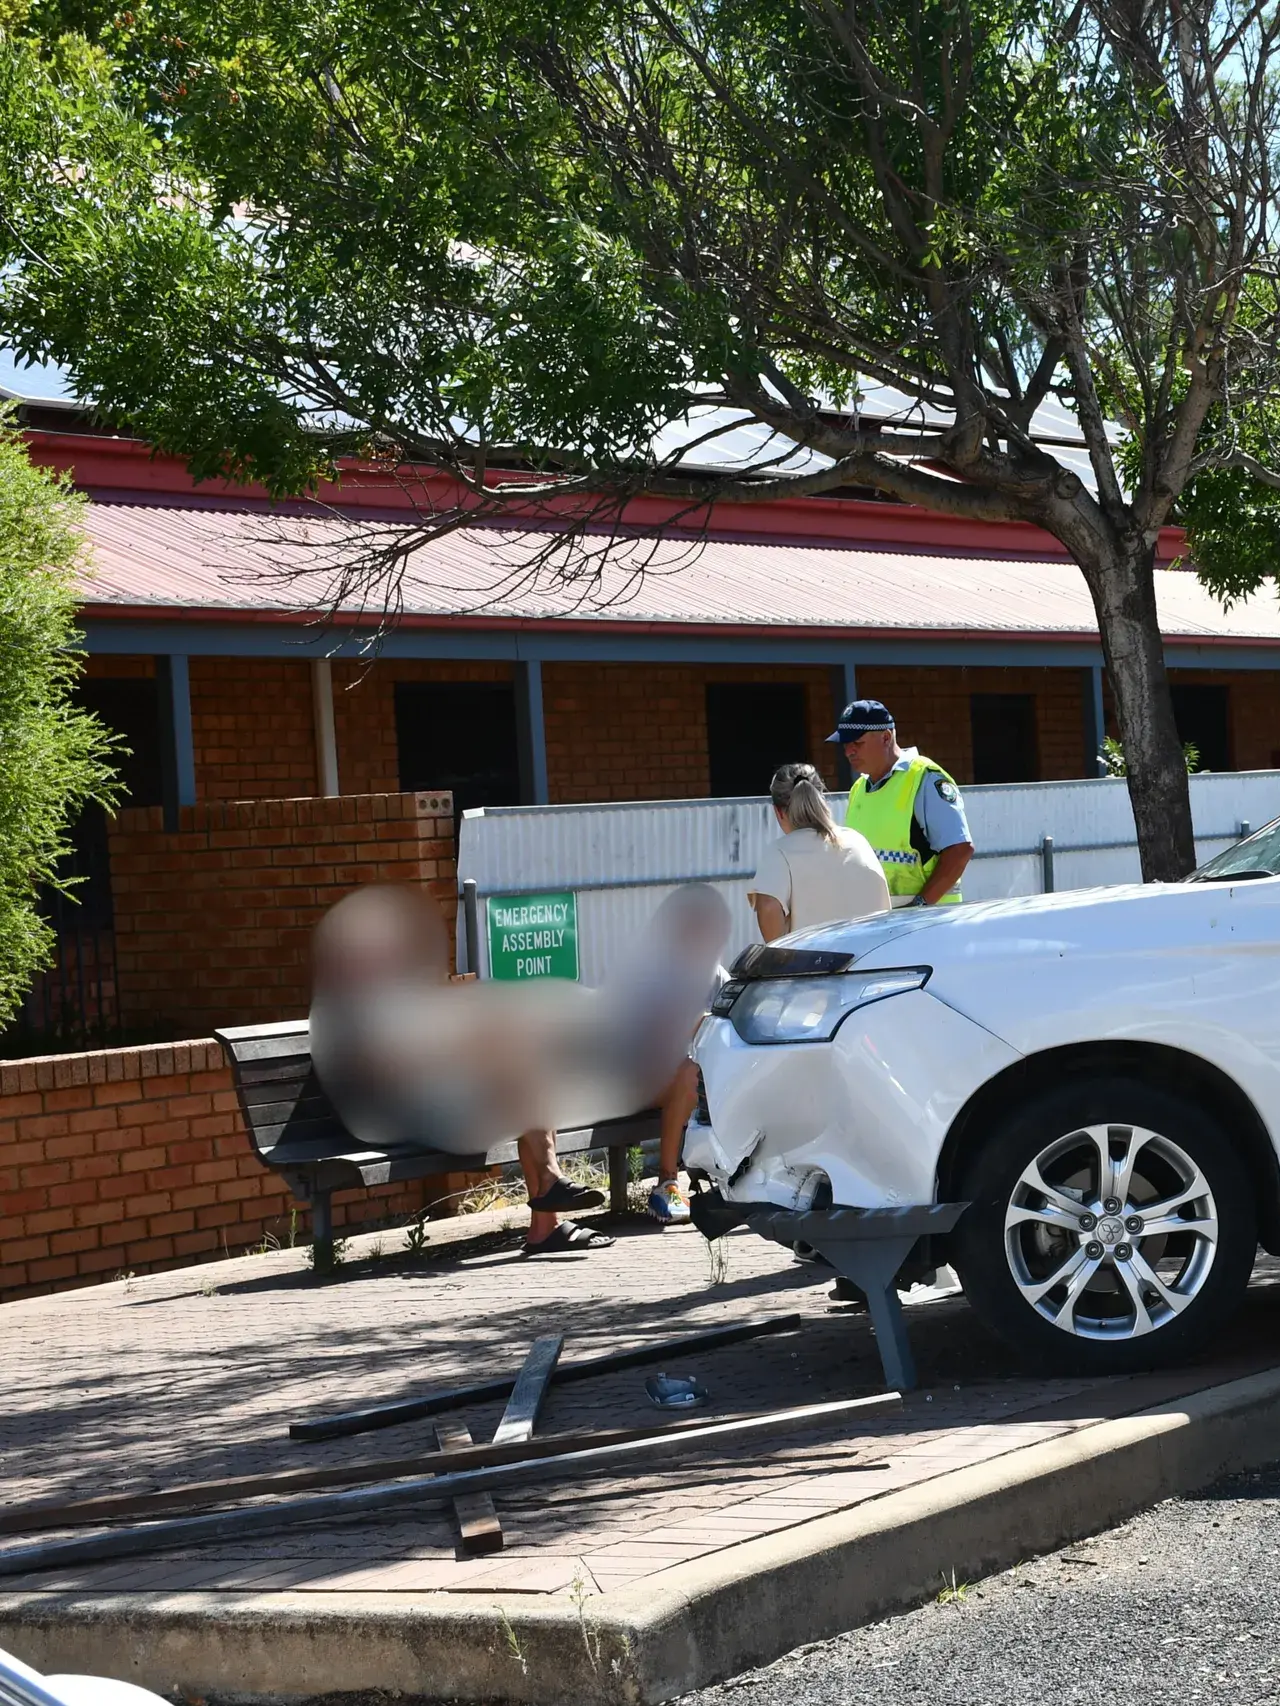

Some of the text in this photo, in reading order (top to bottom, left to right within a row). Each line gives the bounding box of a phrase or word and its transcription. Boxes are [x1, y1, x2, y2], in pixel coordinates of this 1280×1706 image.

[495, 903, 568, 927] EMERGENCY
[502, 929, 565, 953] ASSEMBLY
[516, 955, 552, 977] POINT
